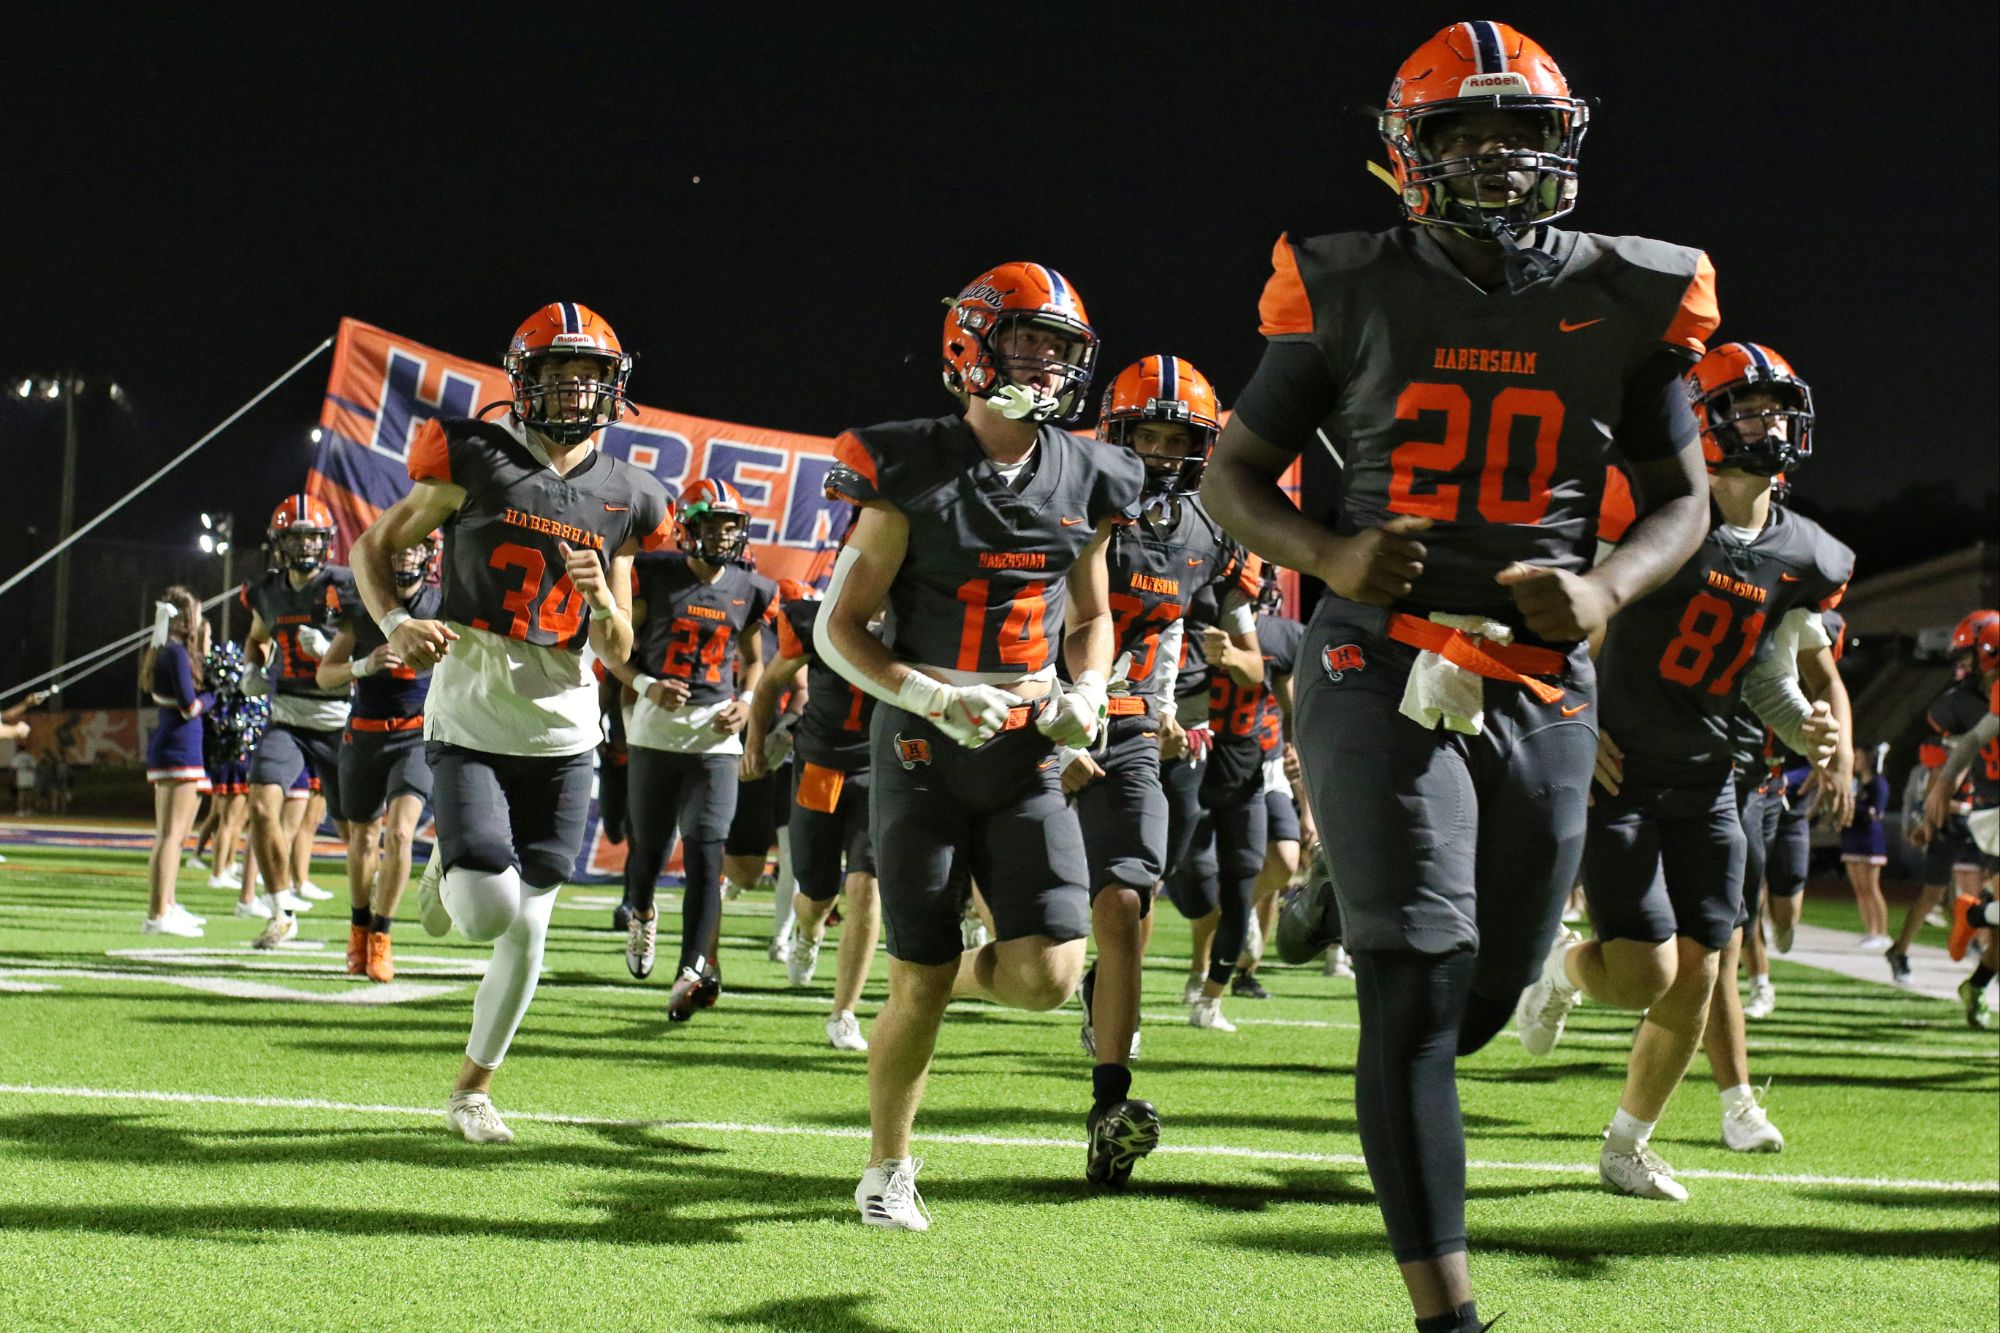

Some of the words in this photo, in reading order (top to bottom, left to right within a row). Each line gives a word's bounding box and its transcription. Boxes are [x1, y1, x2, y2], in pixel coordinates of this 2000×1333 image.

[1434, 348, 1537, 374] HABERSHAM
[1387, 382, 1566, 525] 20
[504, 508, 605, 549] HABERSHAM
[472, 543, 587, 650] 34
[957, 578, 1048, 672] 14
[661, 617, 731, 683] 24
[1659, 591, 1767, 696] 81
[1208, 677, 1263, 737] 28
